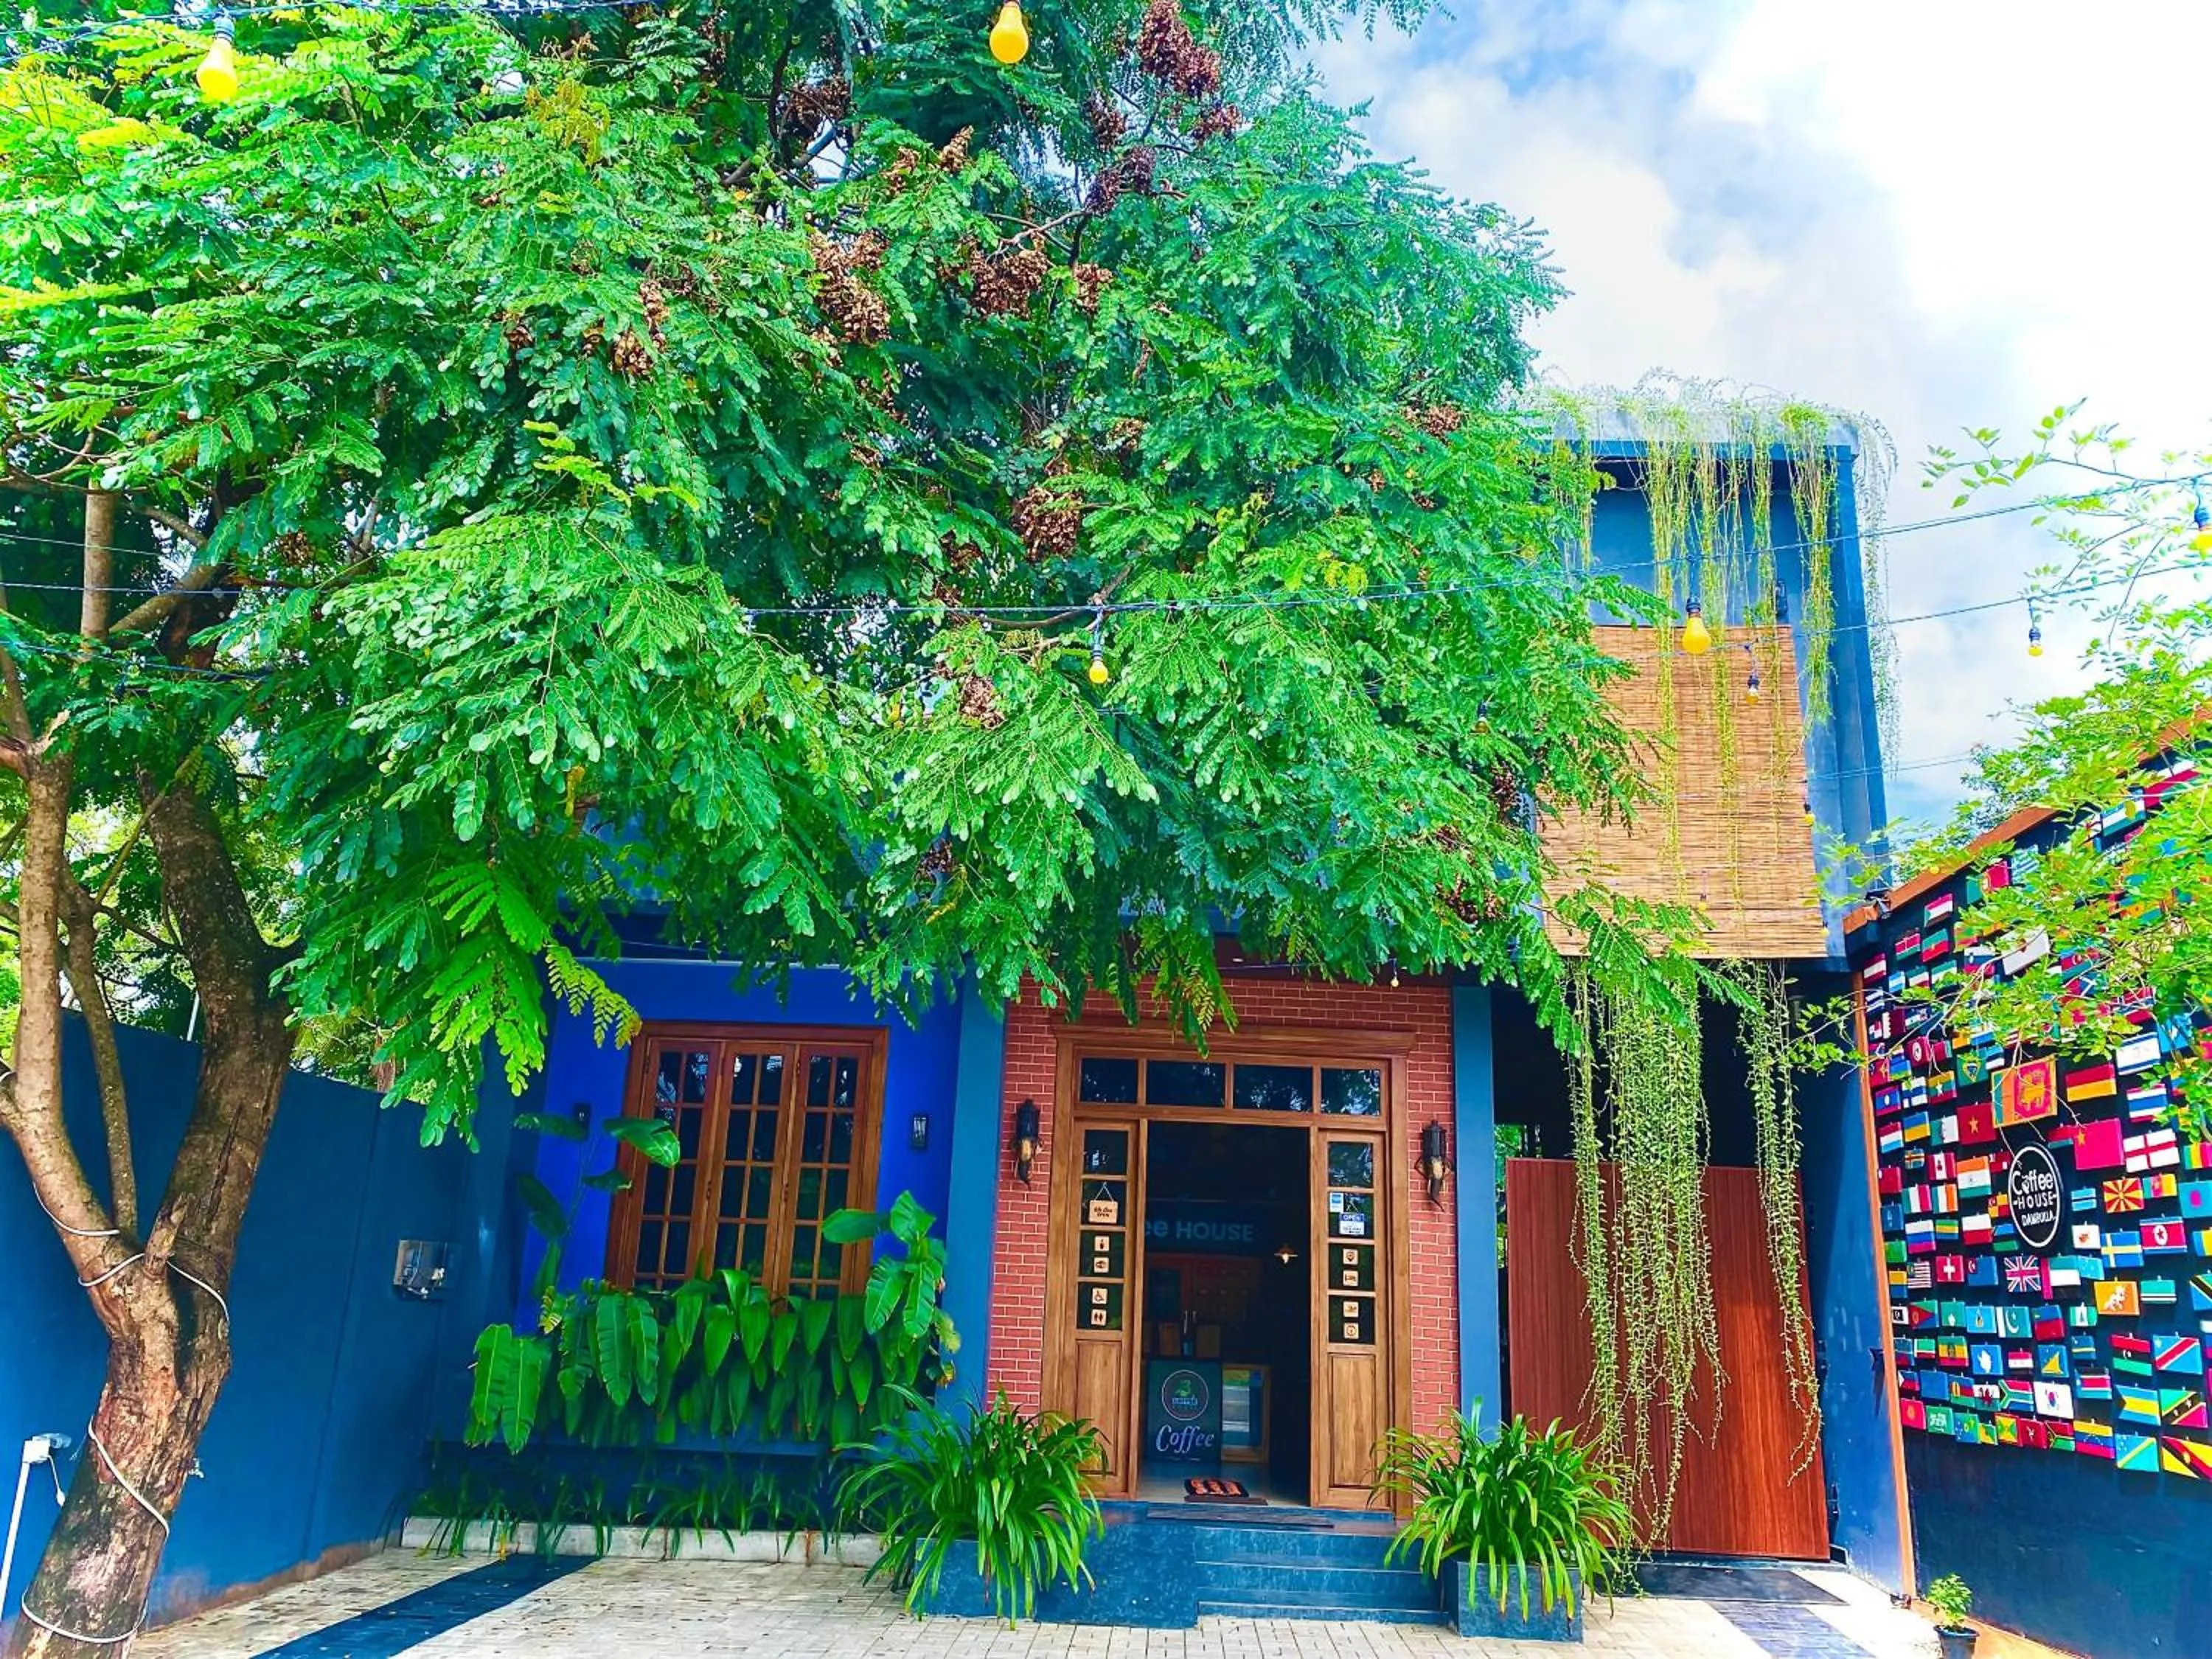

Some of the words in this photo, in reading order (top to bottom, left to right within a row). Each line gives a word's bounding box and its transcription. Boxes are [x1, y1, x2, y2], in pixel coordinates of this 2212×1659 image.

[2012, 1169, 2053, 1195] Coffee
[1175, 1220, 1253, 1242] HOUSE
[1155, 1425, 1214, 1453] Coffee
